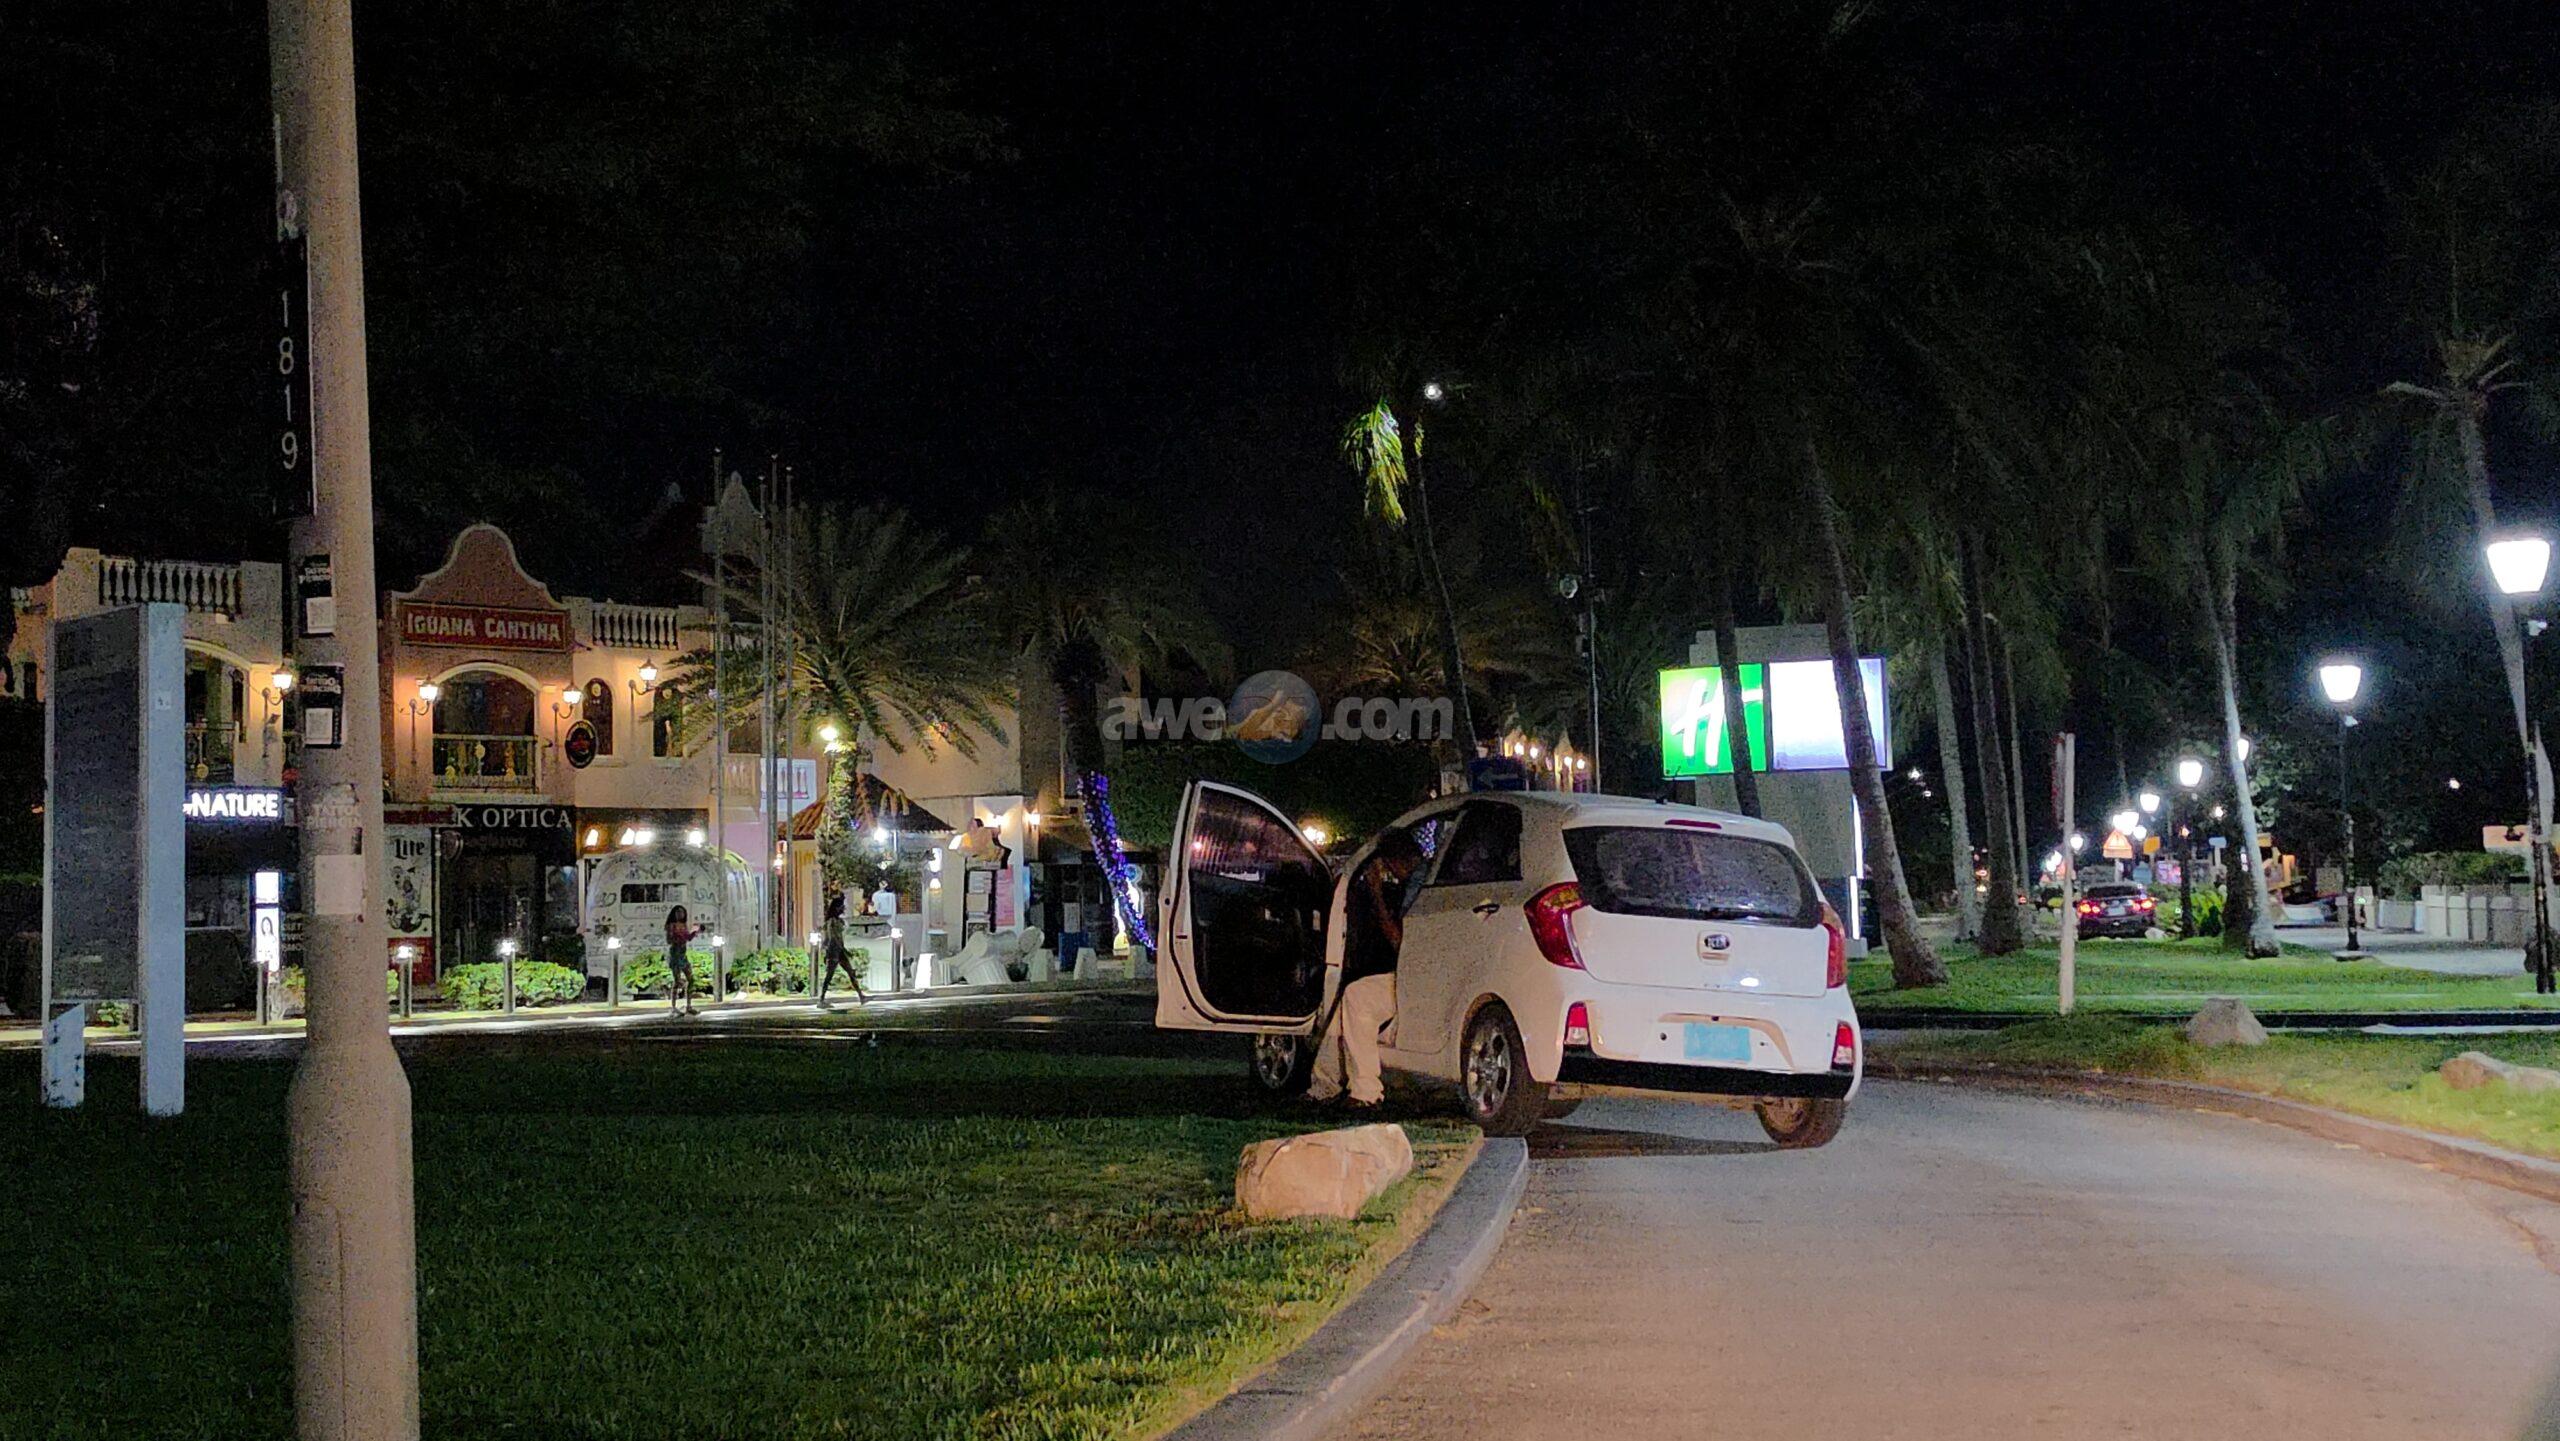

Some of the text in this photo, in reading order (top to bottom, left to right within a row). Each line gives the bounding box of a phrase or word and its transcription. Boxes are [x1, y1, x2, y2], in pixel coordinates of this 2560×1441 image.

[278, 290, 298, 470] 1819
[407, 612, 561, 642] IGUANA CANTINA
[482, 808, 572, 829] OPTICA
[393, 838, 426, 860] Lite
